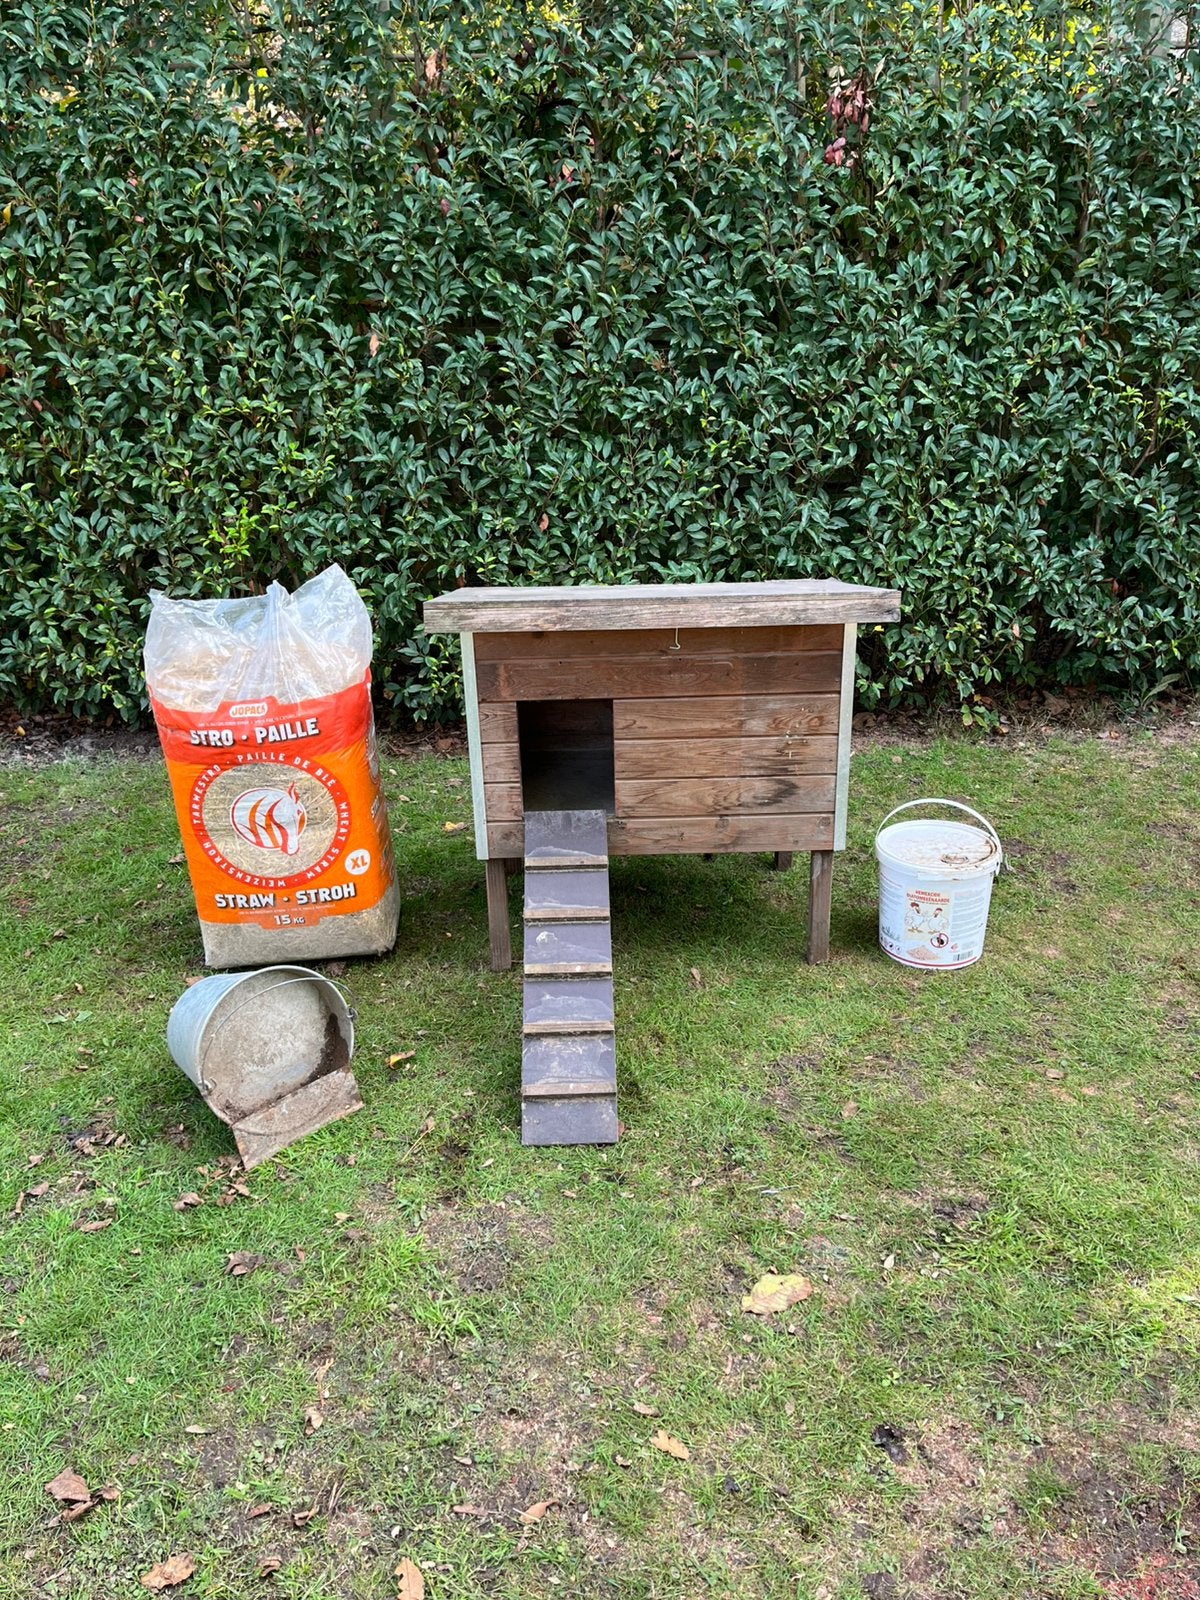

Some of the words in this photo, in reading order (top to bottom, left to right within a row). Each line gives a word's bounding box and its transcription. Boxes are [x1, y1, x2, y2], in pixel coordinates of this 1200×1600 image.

[190, 729, 234, 747] STRO
[255, 718, 320, 743] PAILLE
[237, 752, 286, 762] PAILLE
[294, 757, 310, 769] DE
[192, 764, 221, 825] TARWESTRO
[338, 801, 350, 841] WHEAT
[203, 841, 286, 887] WEIZENSTROH
[306, 848, 340, 879] STRAW
[350, 855, 368, 870] XL
[214, 893, 275, 909] STRAW
[295, 882, 356, 906] STROH
[274, 914, 291, 925] 15
[293, 917, 305, 925] KG
